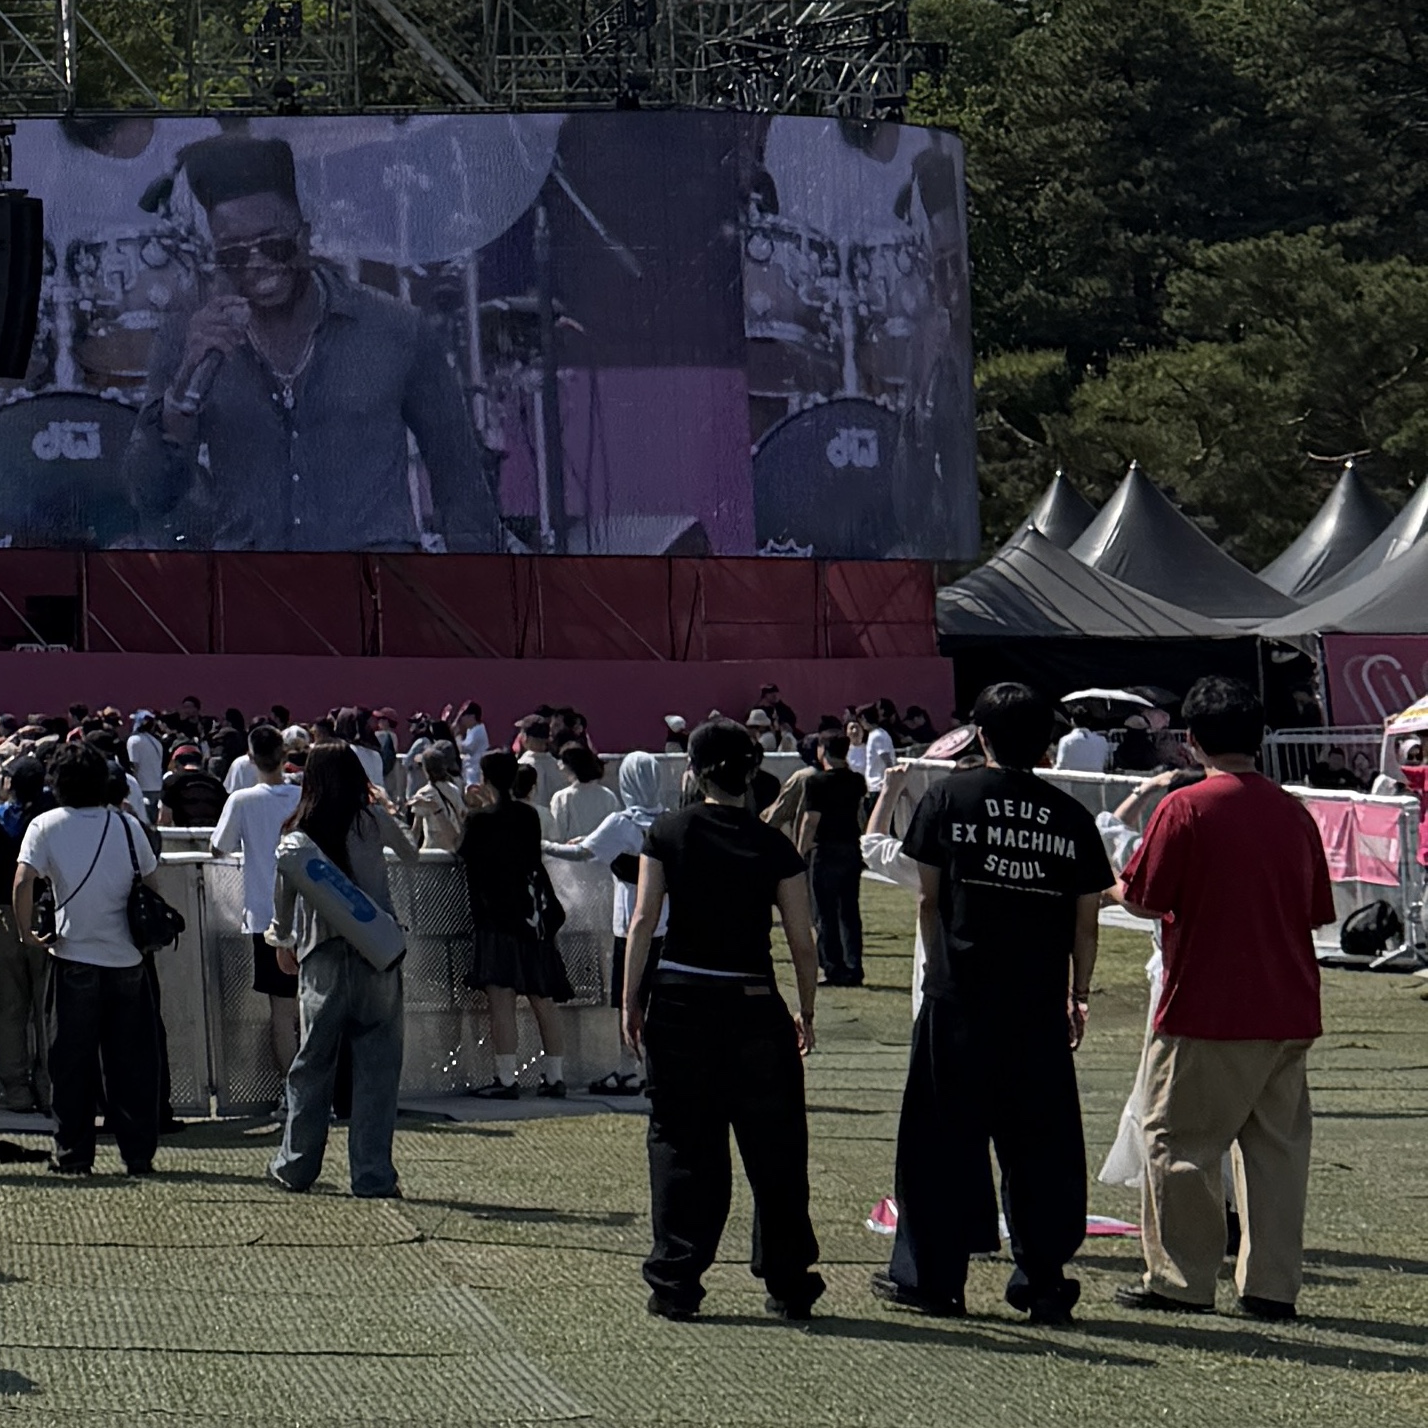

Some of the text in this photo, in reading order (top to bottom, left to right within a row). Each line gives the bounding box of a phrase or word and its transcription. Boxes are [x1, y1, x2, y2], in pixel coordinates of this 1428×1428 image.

[985, 799, 1051, 824] DEUS
[952, 823, 1076, 860] EX MACHINA
[984, 854, 1046, 880] SEOUL
